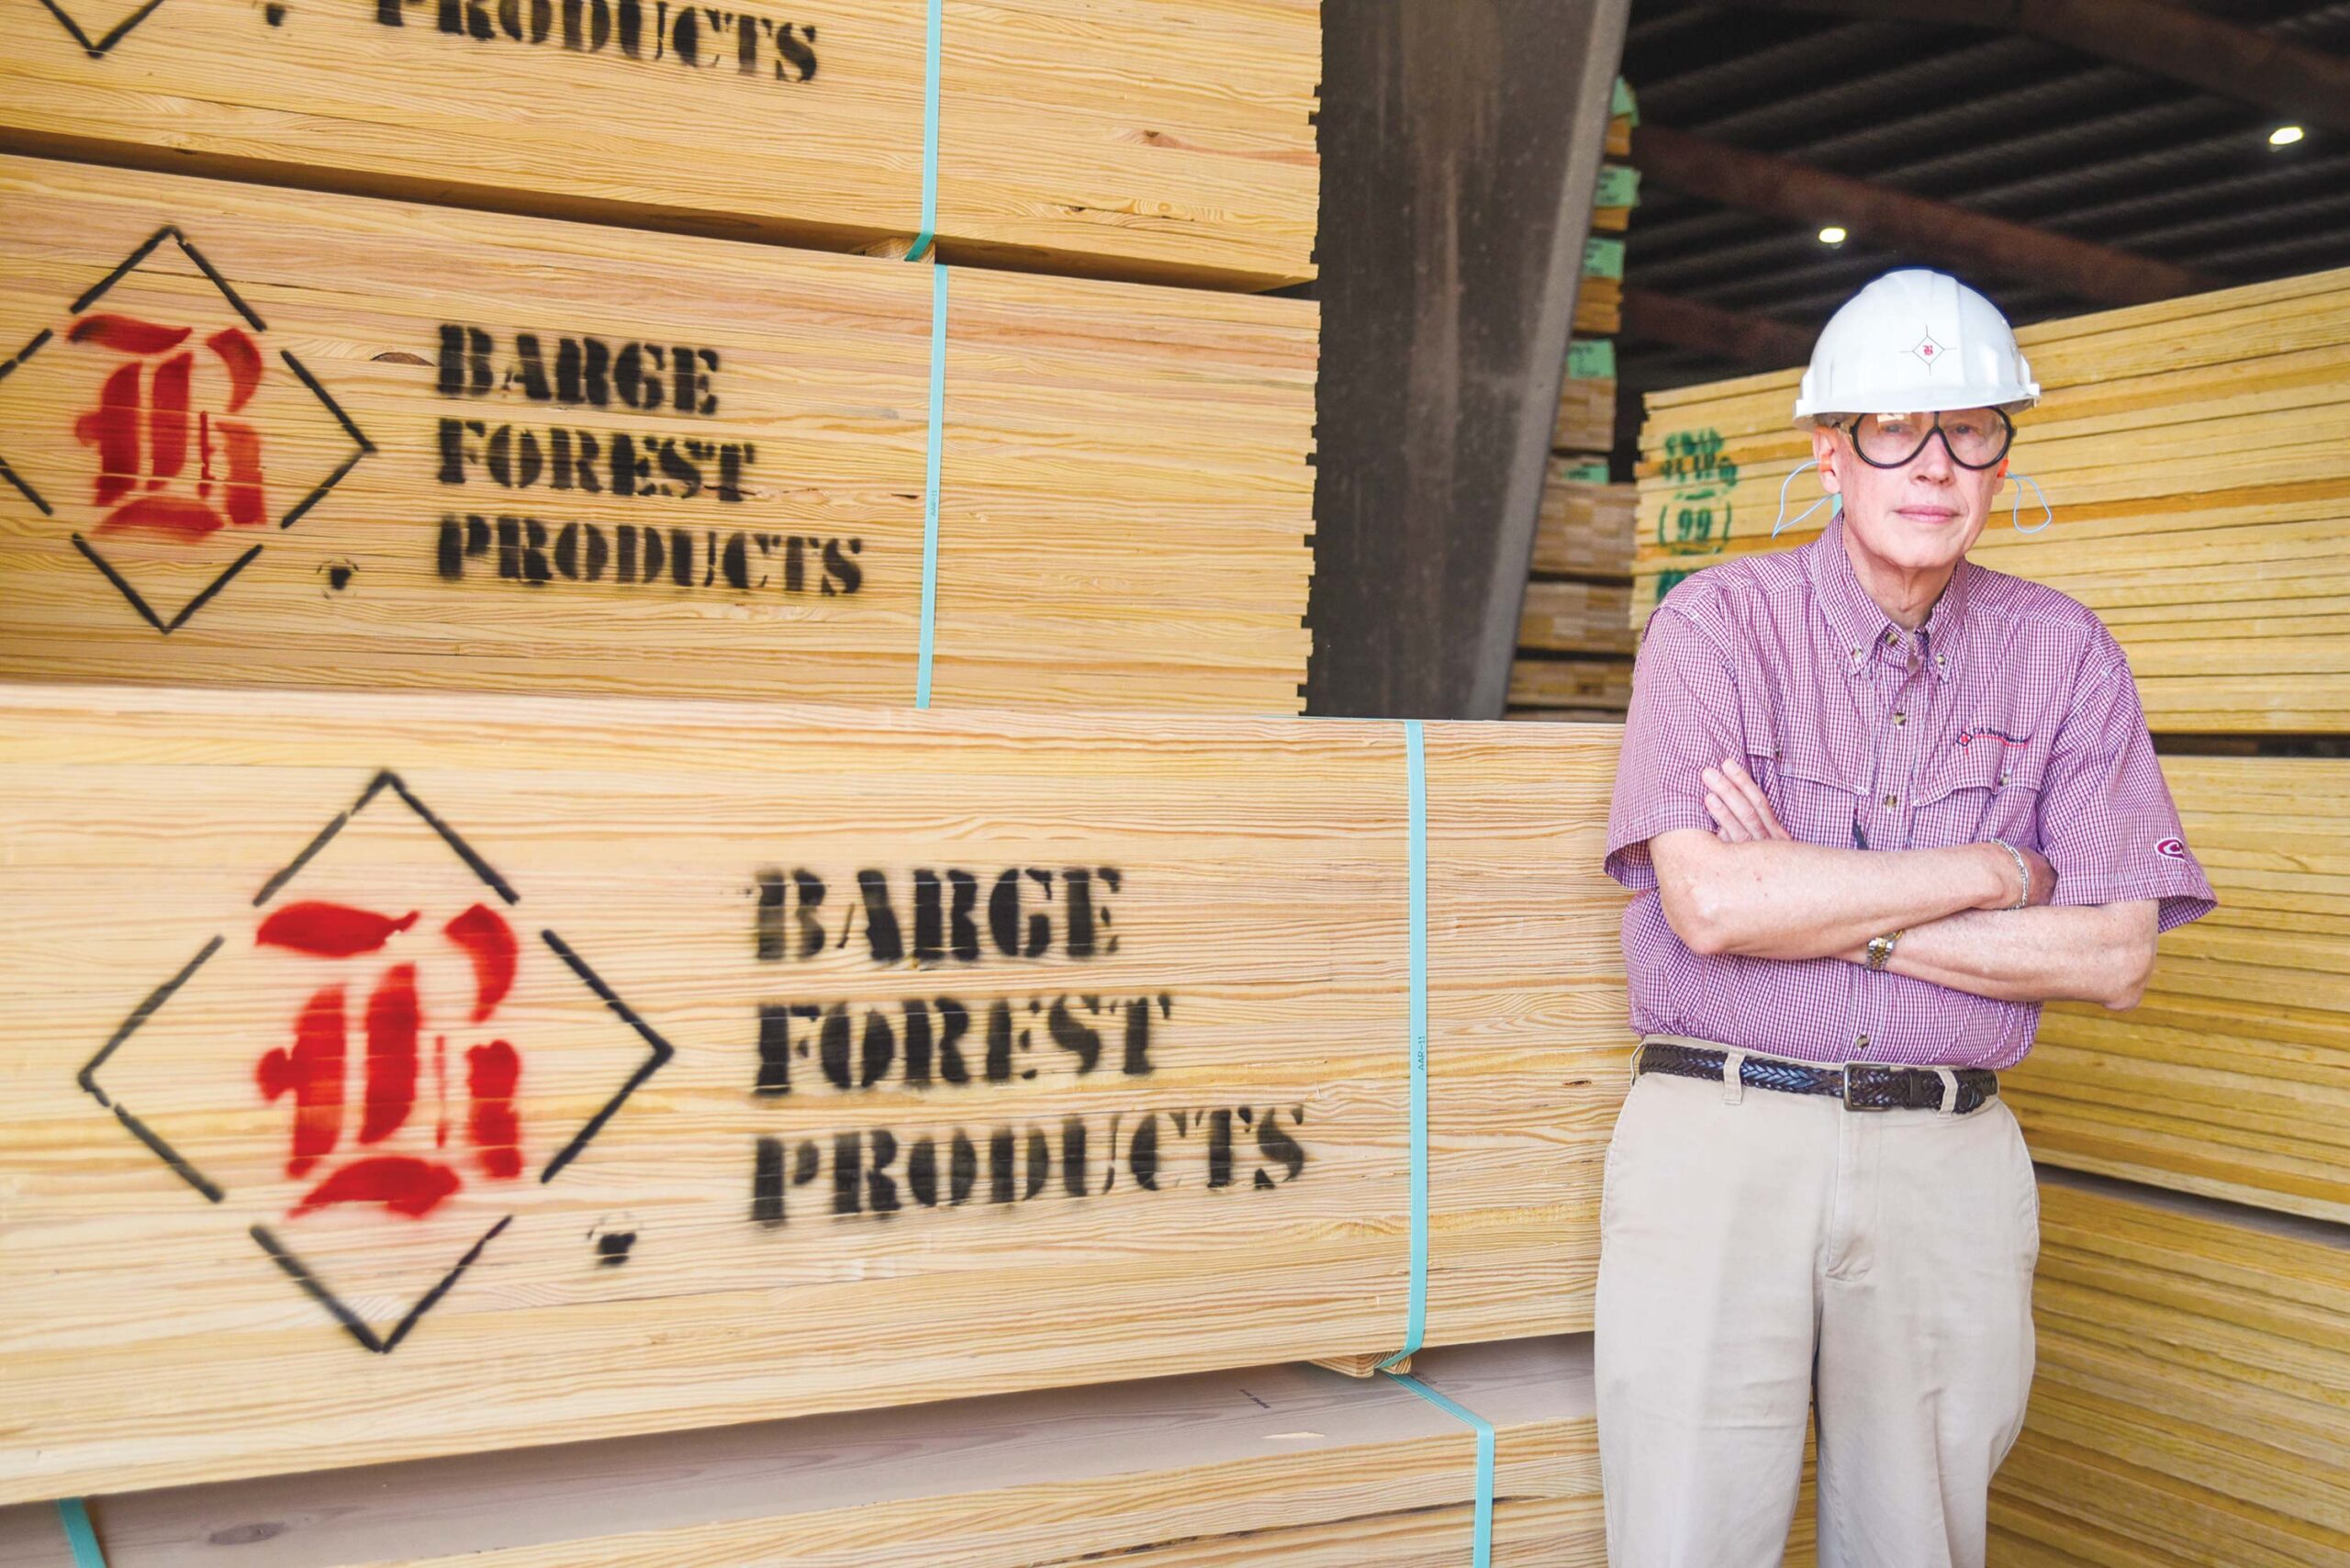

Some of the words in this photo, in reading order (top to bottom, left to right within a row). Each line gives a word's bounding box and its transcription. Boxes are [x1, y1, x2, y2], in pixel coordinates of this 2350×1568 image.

[438, 324, 719, 415] BARGE
[438, 418, 755, 502] FOREST
[438, 514, 863, 597] PRODUCTS
[756, 868, 1122, 962] BARGE
[755, 994, 1171, 1096] FOREST
[752, 1104, 1305, 1227] PRODUCTS
